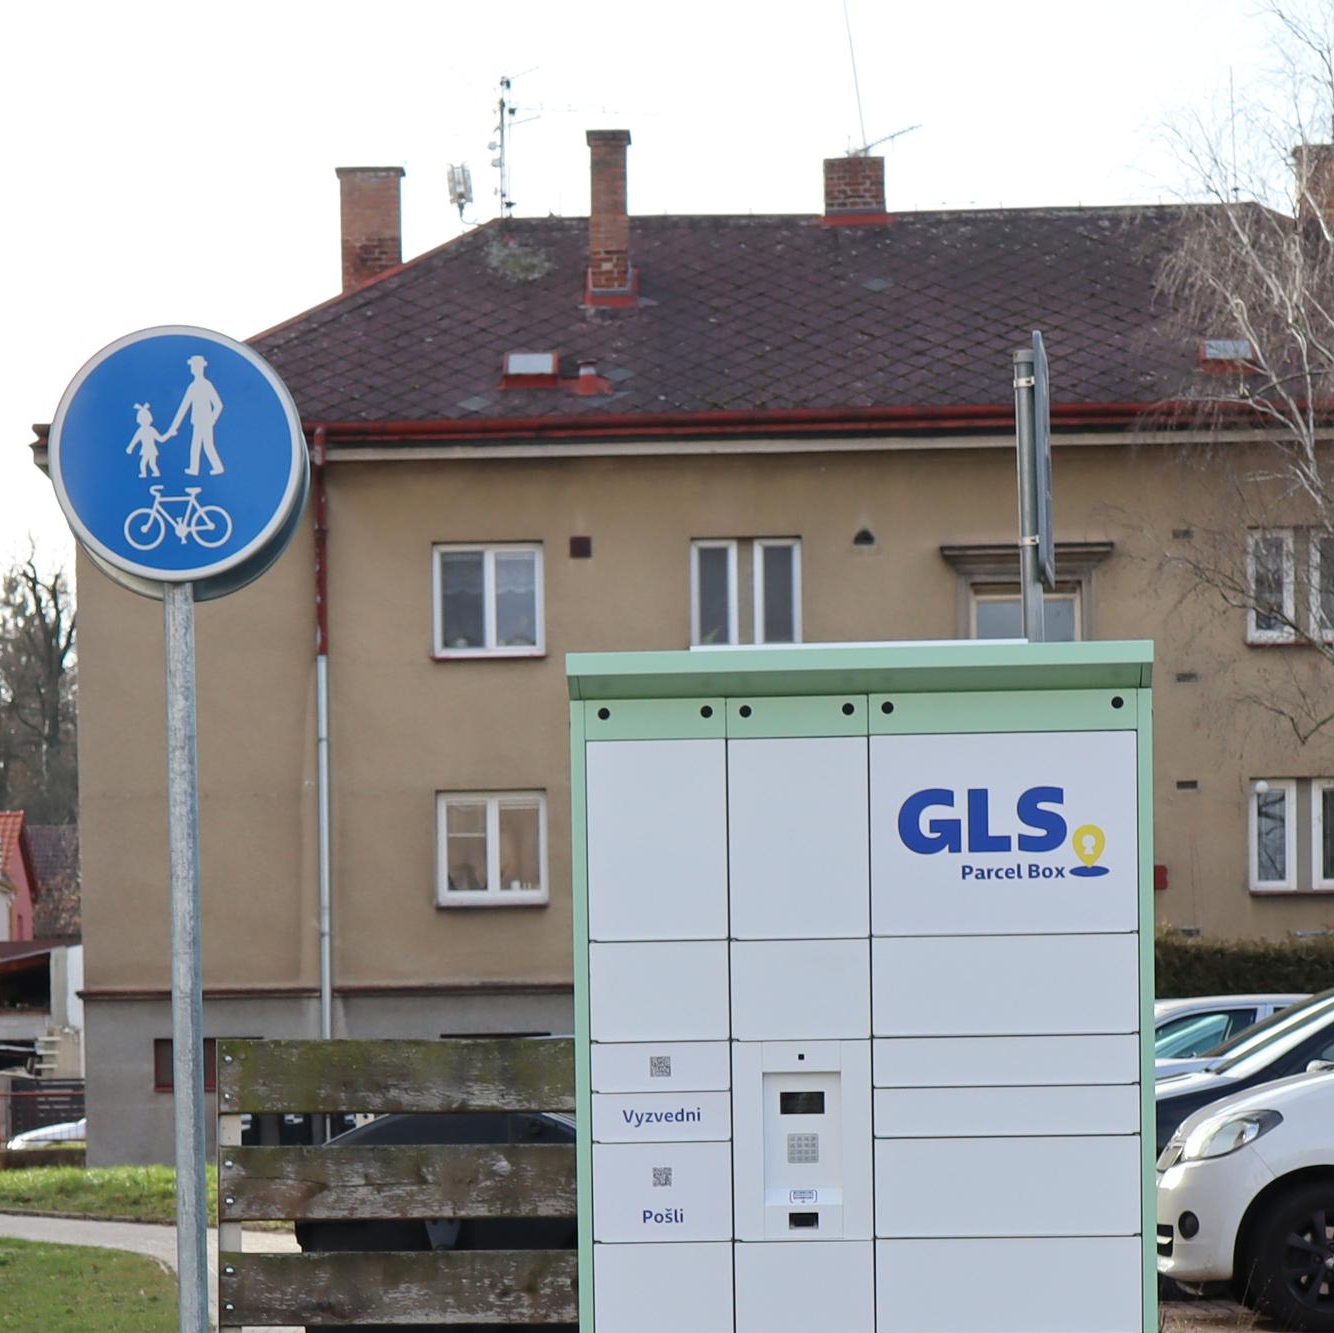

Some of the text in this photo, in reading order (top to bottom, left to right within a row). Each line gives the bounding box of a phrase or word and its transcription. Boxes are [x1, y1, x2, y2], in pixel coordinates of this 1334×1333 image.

[897, 785, 1068, 856] GLS
[961, 863, 1066, 881] Parcel Box
[622, 1107, 702, 1128] Vyzvedni
[642, 1207, 685, 1225] Pošli
